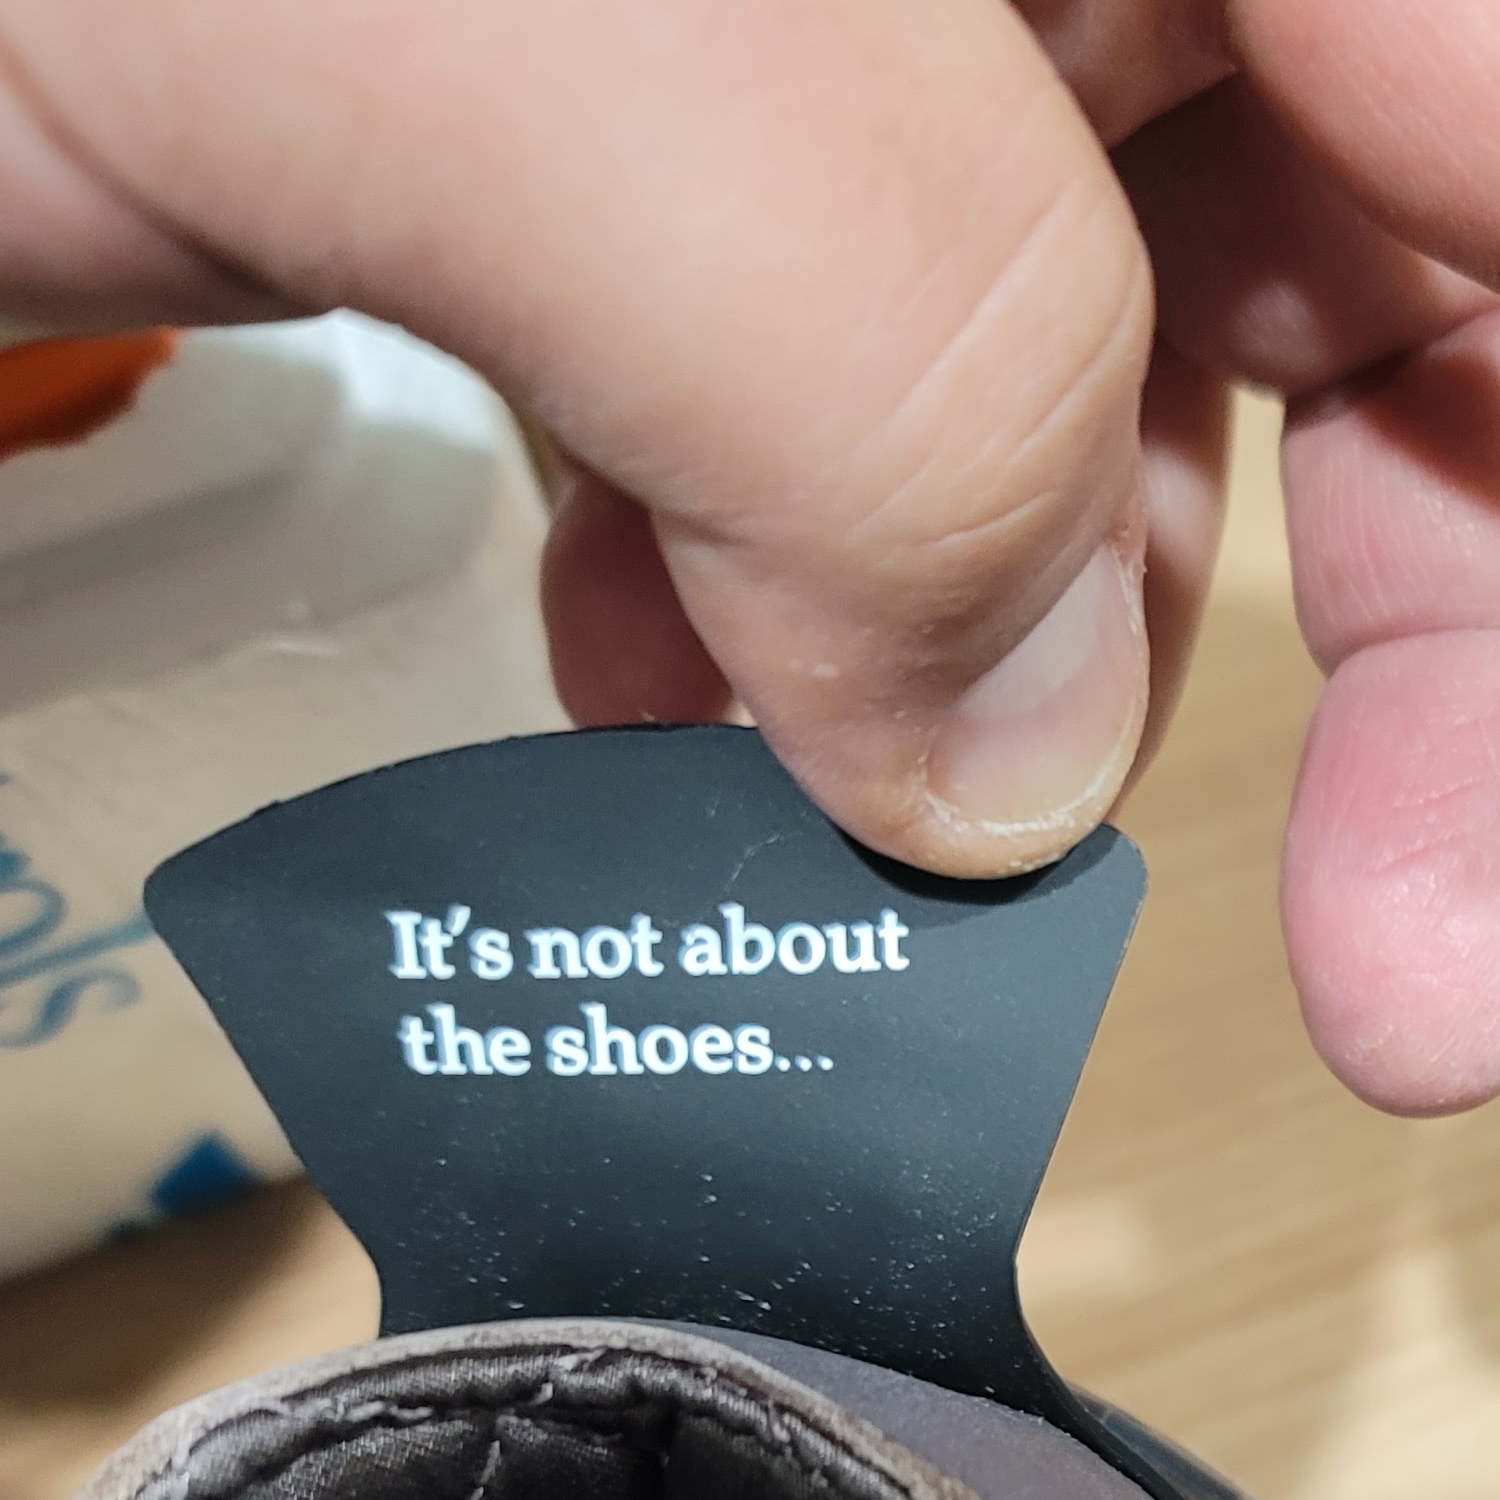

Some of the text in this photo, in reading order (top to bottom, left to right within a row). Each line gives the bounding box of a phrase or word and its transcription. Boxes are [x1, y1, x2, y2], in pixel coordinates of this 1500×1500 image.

[386, 902, 911, 980] It's not about
[399, 1002, 834, 1077] the shoes...
